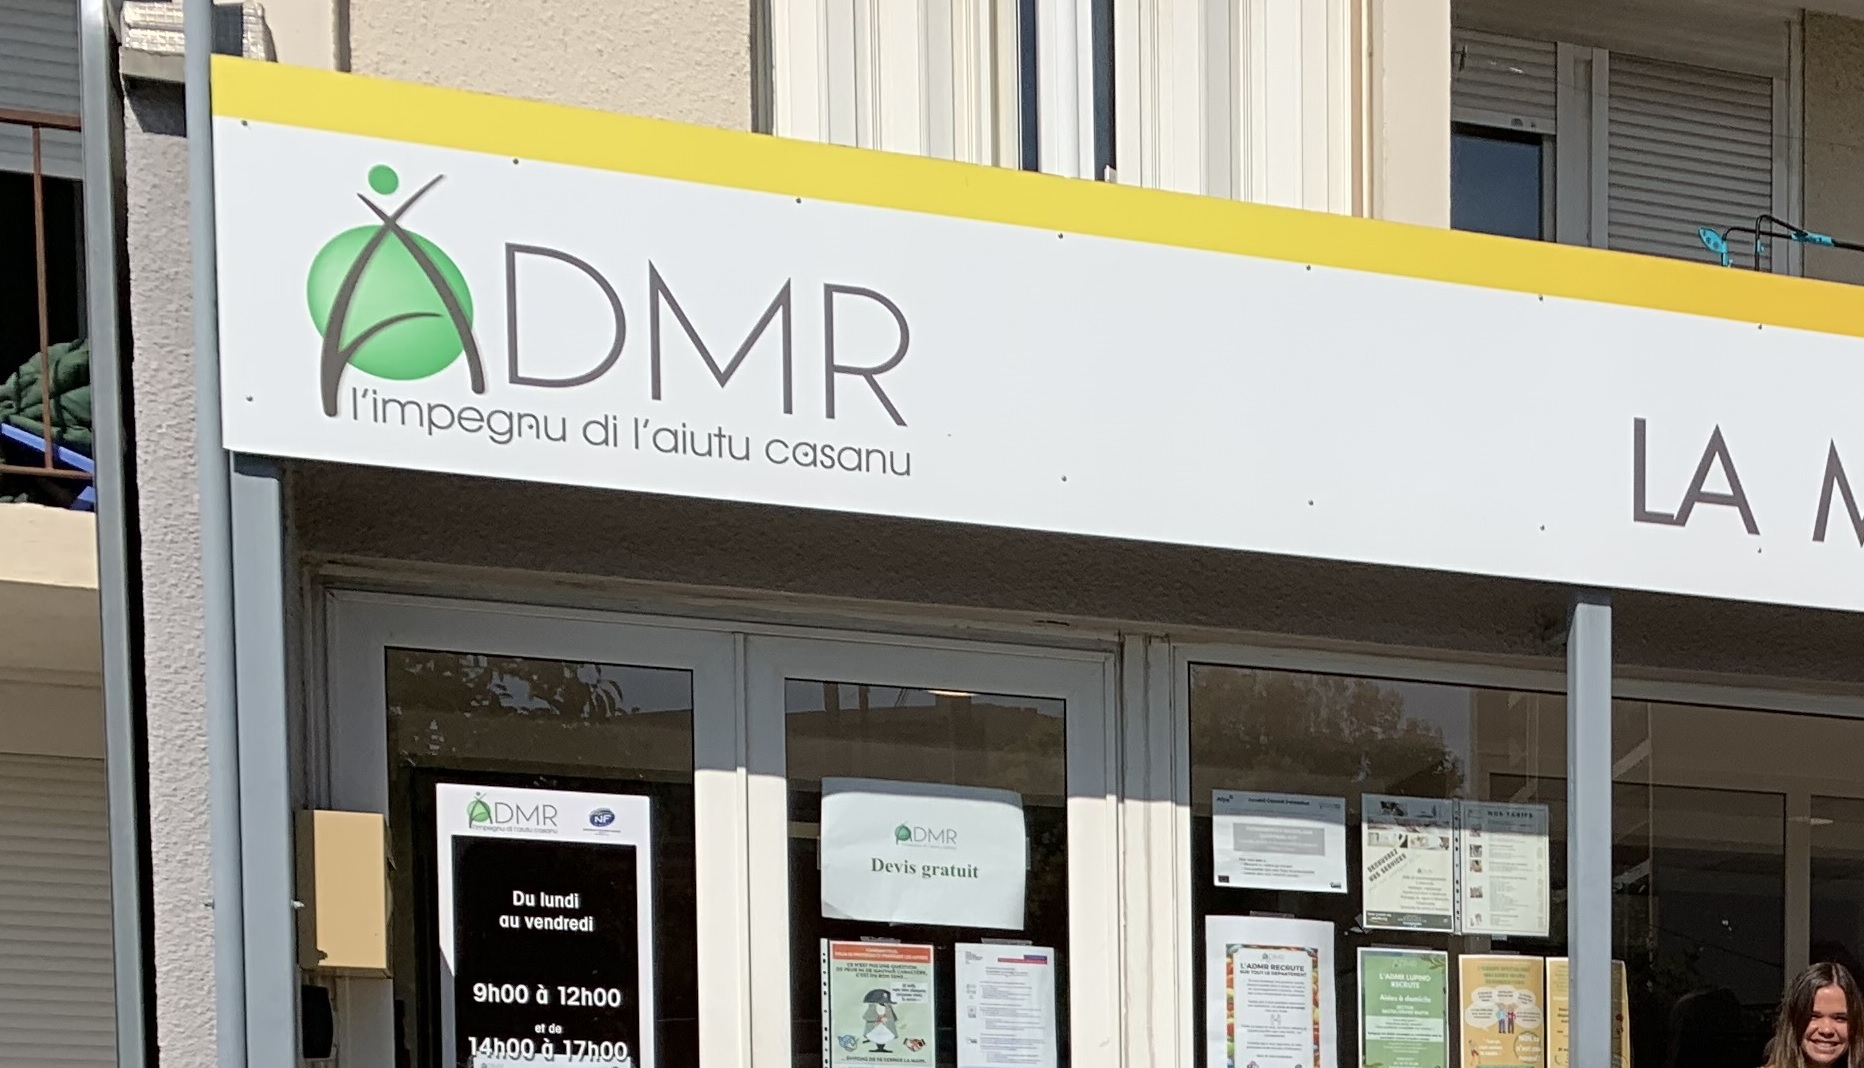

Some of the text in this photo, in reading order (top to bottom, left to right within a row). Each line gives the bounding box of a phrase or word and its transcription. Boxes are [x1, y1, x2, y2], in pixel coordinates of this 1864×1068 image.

[318, 170, 909, 428] ADMR
[351, 386, 912, 477] l'impegnu di l'aiutu casanu
[1633, 417, 1760, 536] LA
[468, 793, 558, 829] ADMR
[594, 814, 611, 824] NF
[871, 857, 979, 879] Devis gratuit
[512, 890, 580, 909] Du lundi
[499, 914, 594, 931] au vendredi
[1270, 964, 1305, 972] RECRUTE
[473, 982, 621, 1007] 9h00 à 12h00
[1390, 981, 1421, 989] RECRUTE
[534, 1023, 562, 1034] et de
[468, 1036, 628, 1061] 14h00 à 17h00
